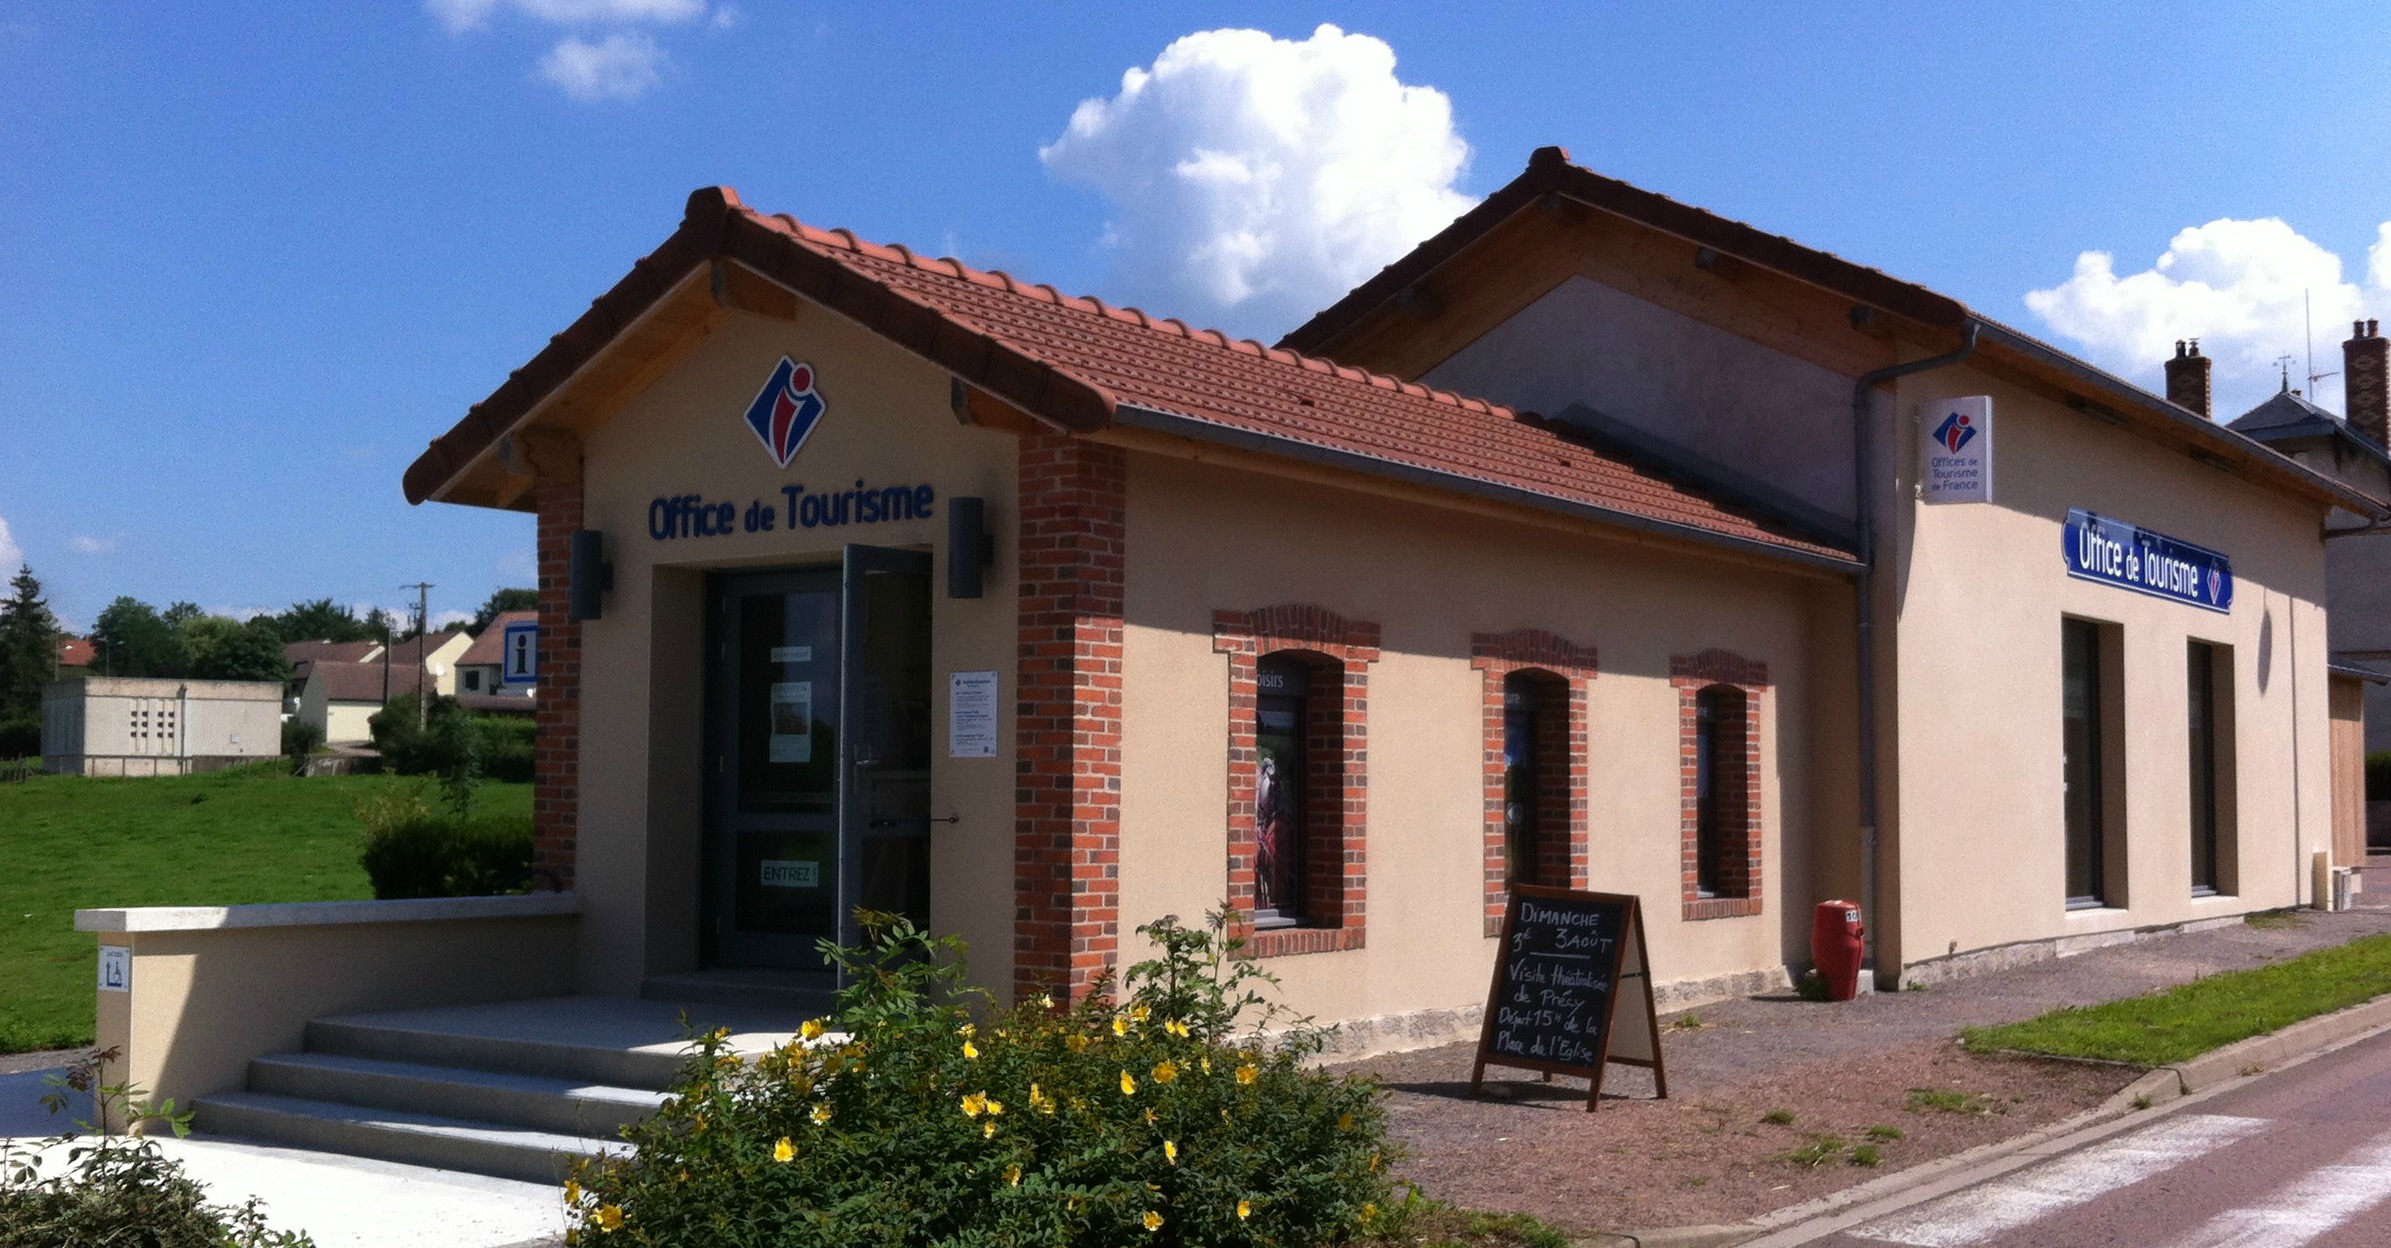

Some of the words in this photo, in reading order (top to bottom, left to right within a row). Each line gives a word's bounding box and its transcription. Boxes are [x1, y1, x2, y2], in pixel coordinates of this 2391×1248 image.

[1931, 456, 1966, 468] Offices
[1968, 458, 1978, 466] de
[1932, 468, 1978, 479] Tourisme
[1931, 483, 1940, 491] de
[1943, 480, 1979, 491] France
[649, 494, 735, 540] Office
[744, 498, 775, 532] de
[781, 479, 934, 530] Tourisme
[2079, 521, 2122, 577] Office
[2126, 547, 2139, 582] de
[2141, 539, 2198, 598] Tourisme
[764, 866, 810, 881] ENTREZ
[1514, 984, 1531, 1003] de
[1564, 1016, 1581, 1034] de
[1585, 1016, 1598, 1035] la
[1497, 1030, 1525, 1055] Place
[1529, 1034, 1546, 1056] de
